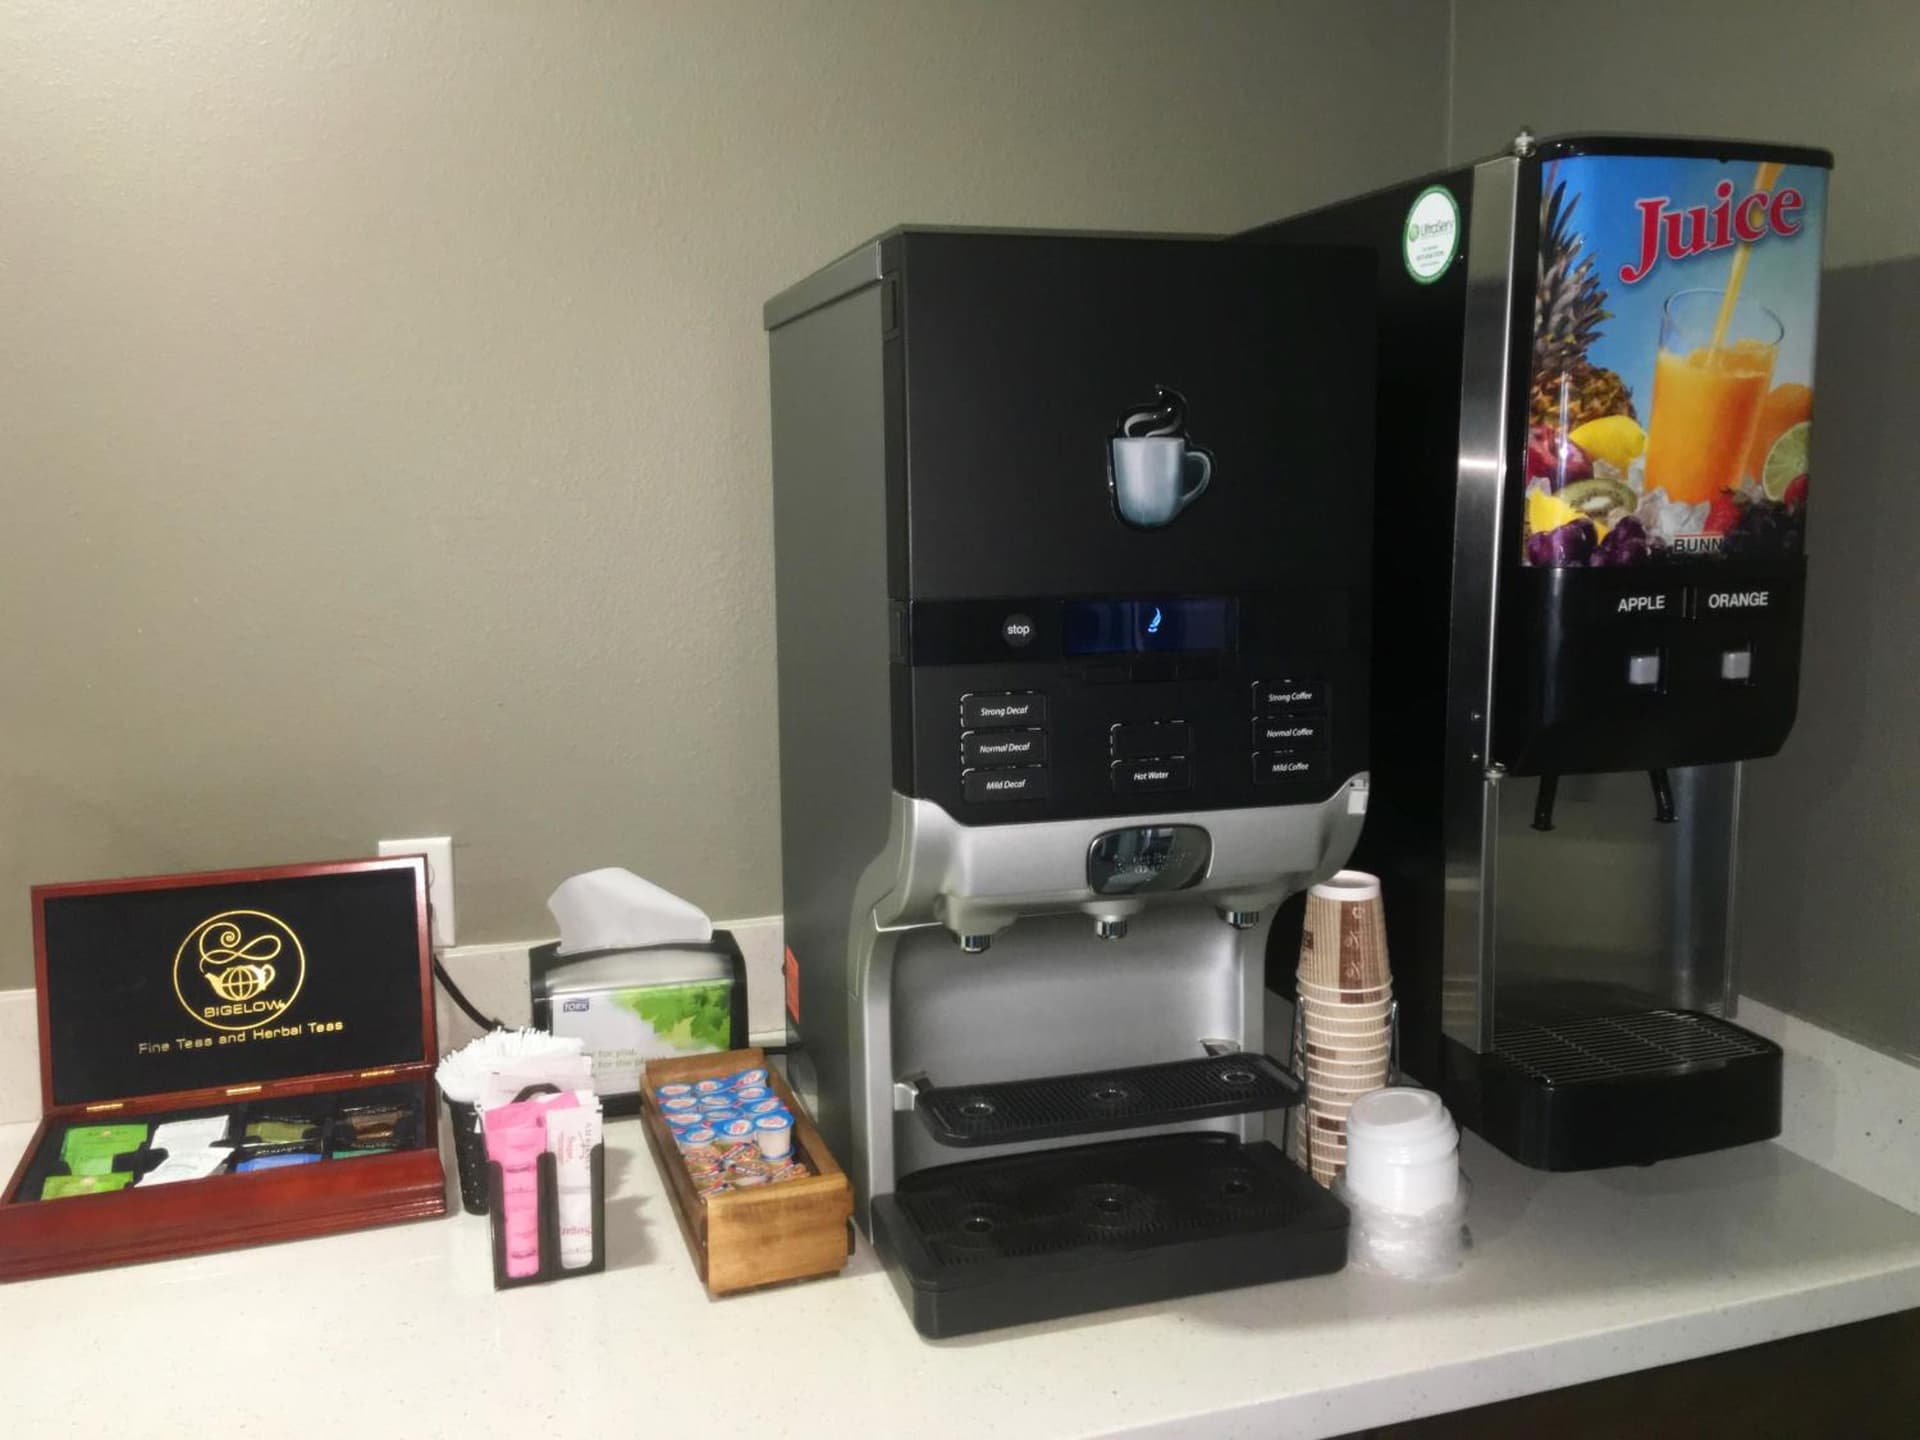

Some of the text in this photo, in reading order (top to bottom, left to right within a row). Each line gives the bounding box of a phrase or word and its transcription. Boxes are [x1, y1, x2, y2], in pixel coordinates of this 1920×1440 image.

[1619, 179, 1803, 284] Juice
[1674, 538, 1723, 552] BUNN
[1618, 595, 1666, 612] APPLE
[1708, 591, 1770, 608] ORANGE
[1007, 624, 1030, 637] stop
[1268, 692, 1312, 703] Strong Coffee
[980, 705, 1029, 718] Strong Decaf
[1267, 728, 1313, 738] Normal Coffee
[979, 741, 1031, 753] Normal Decaf
[1272, 762, 1309, 772] Mild Coffee
[1133, 771, 1169, 780] Hot Water
[986, 779, 1026, 791] Mild Decaf
[203, 999, 281, 1018] BIGELOW
[563, 1001, 590, 1012] TORK
[138, 1020, 344, 1055] Fine Teas and Herbal Teas
